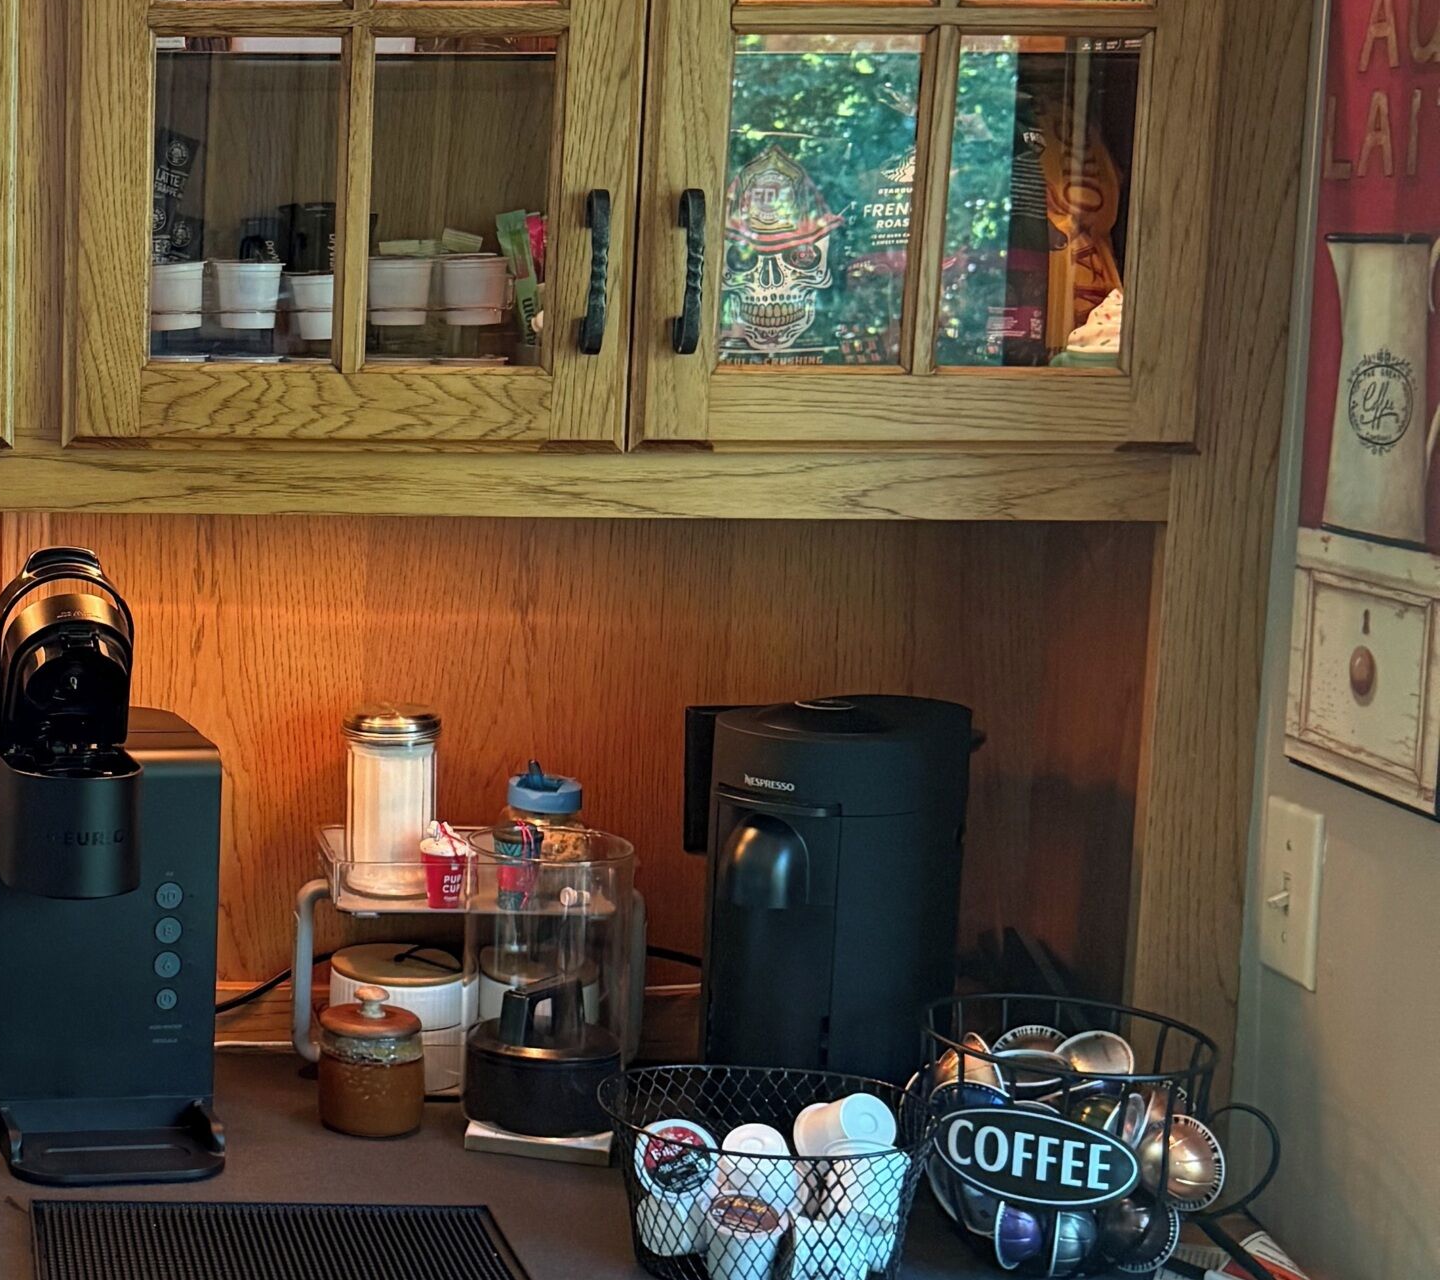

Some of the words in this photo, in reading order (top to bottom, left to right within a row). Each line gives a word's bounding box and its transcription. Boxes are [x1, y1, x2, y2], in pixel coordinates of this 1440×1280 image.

[1322, 87, 1440, 182] LAI
[155, 167, 181, 188] LATTE
[862, 202, 913, 219] FREN
[744, 773, 795, 793] NESPRESSO
[946, 1118, 1114, 1191] COFFEE
